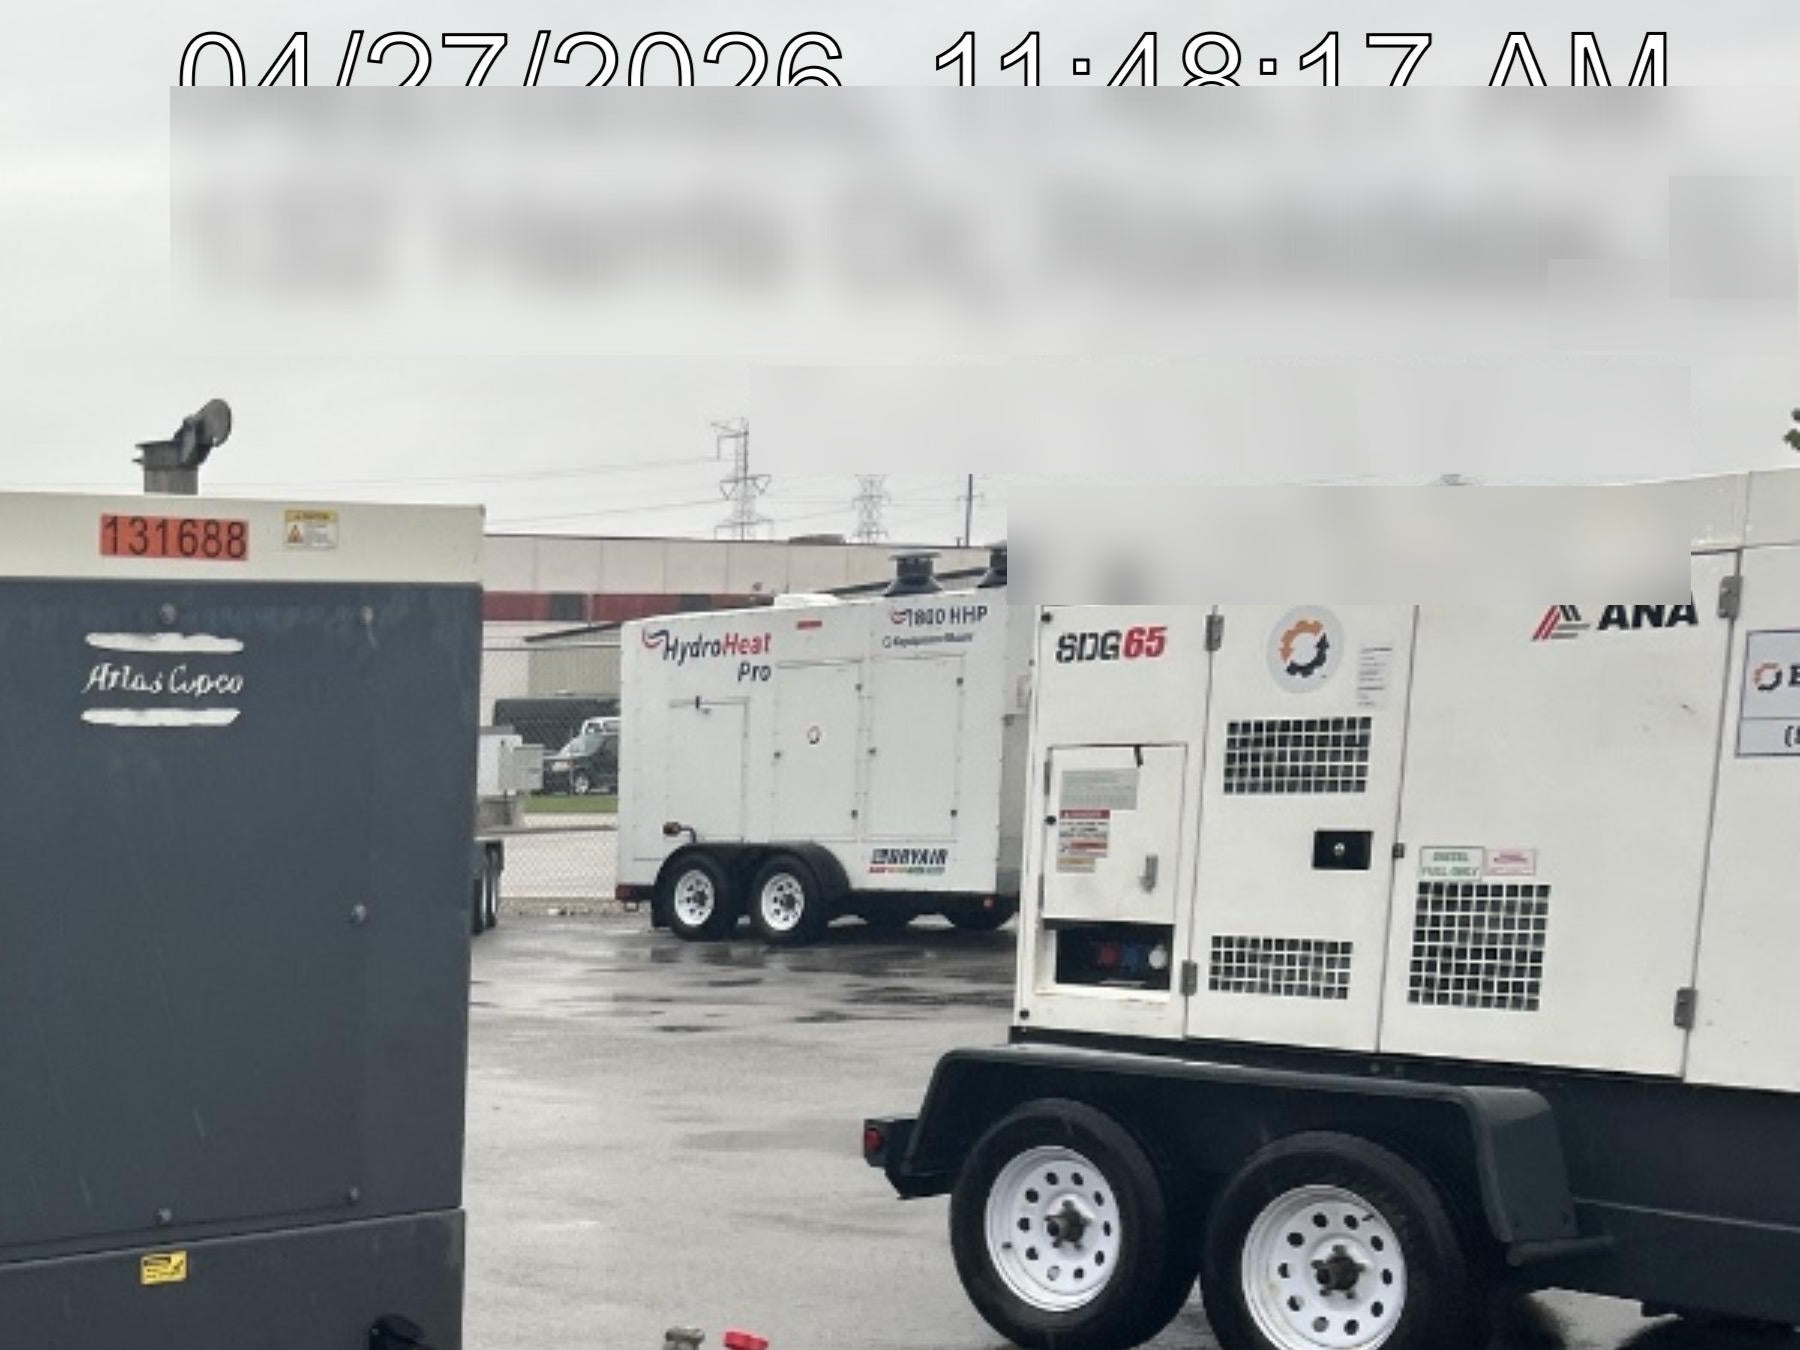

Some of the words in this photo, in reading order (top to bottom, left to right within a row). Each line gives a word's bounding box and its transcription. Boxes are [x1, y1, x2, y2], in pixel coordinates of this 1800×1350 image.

[104, 515, 247, 560] 131688
[949, 605, 988, 625] HHP
[1597, 592, 1699, 631] ANA
[663, 630, 772, 667] HydroHeat
[737, 661, 772, 683] Pro
